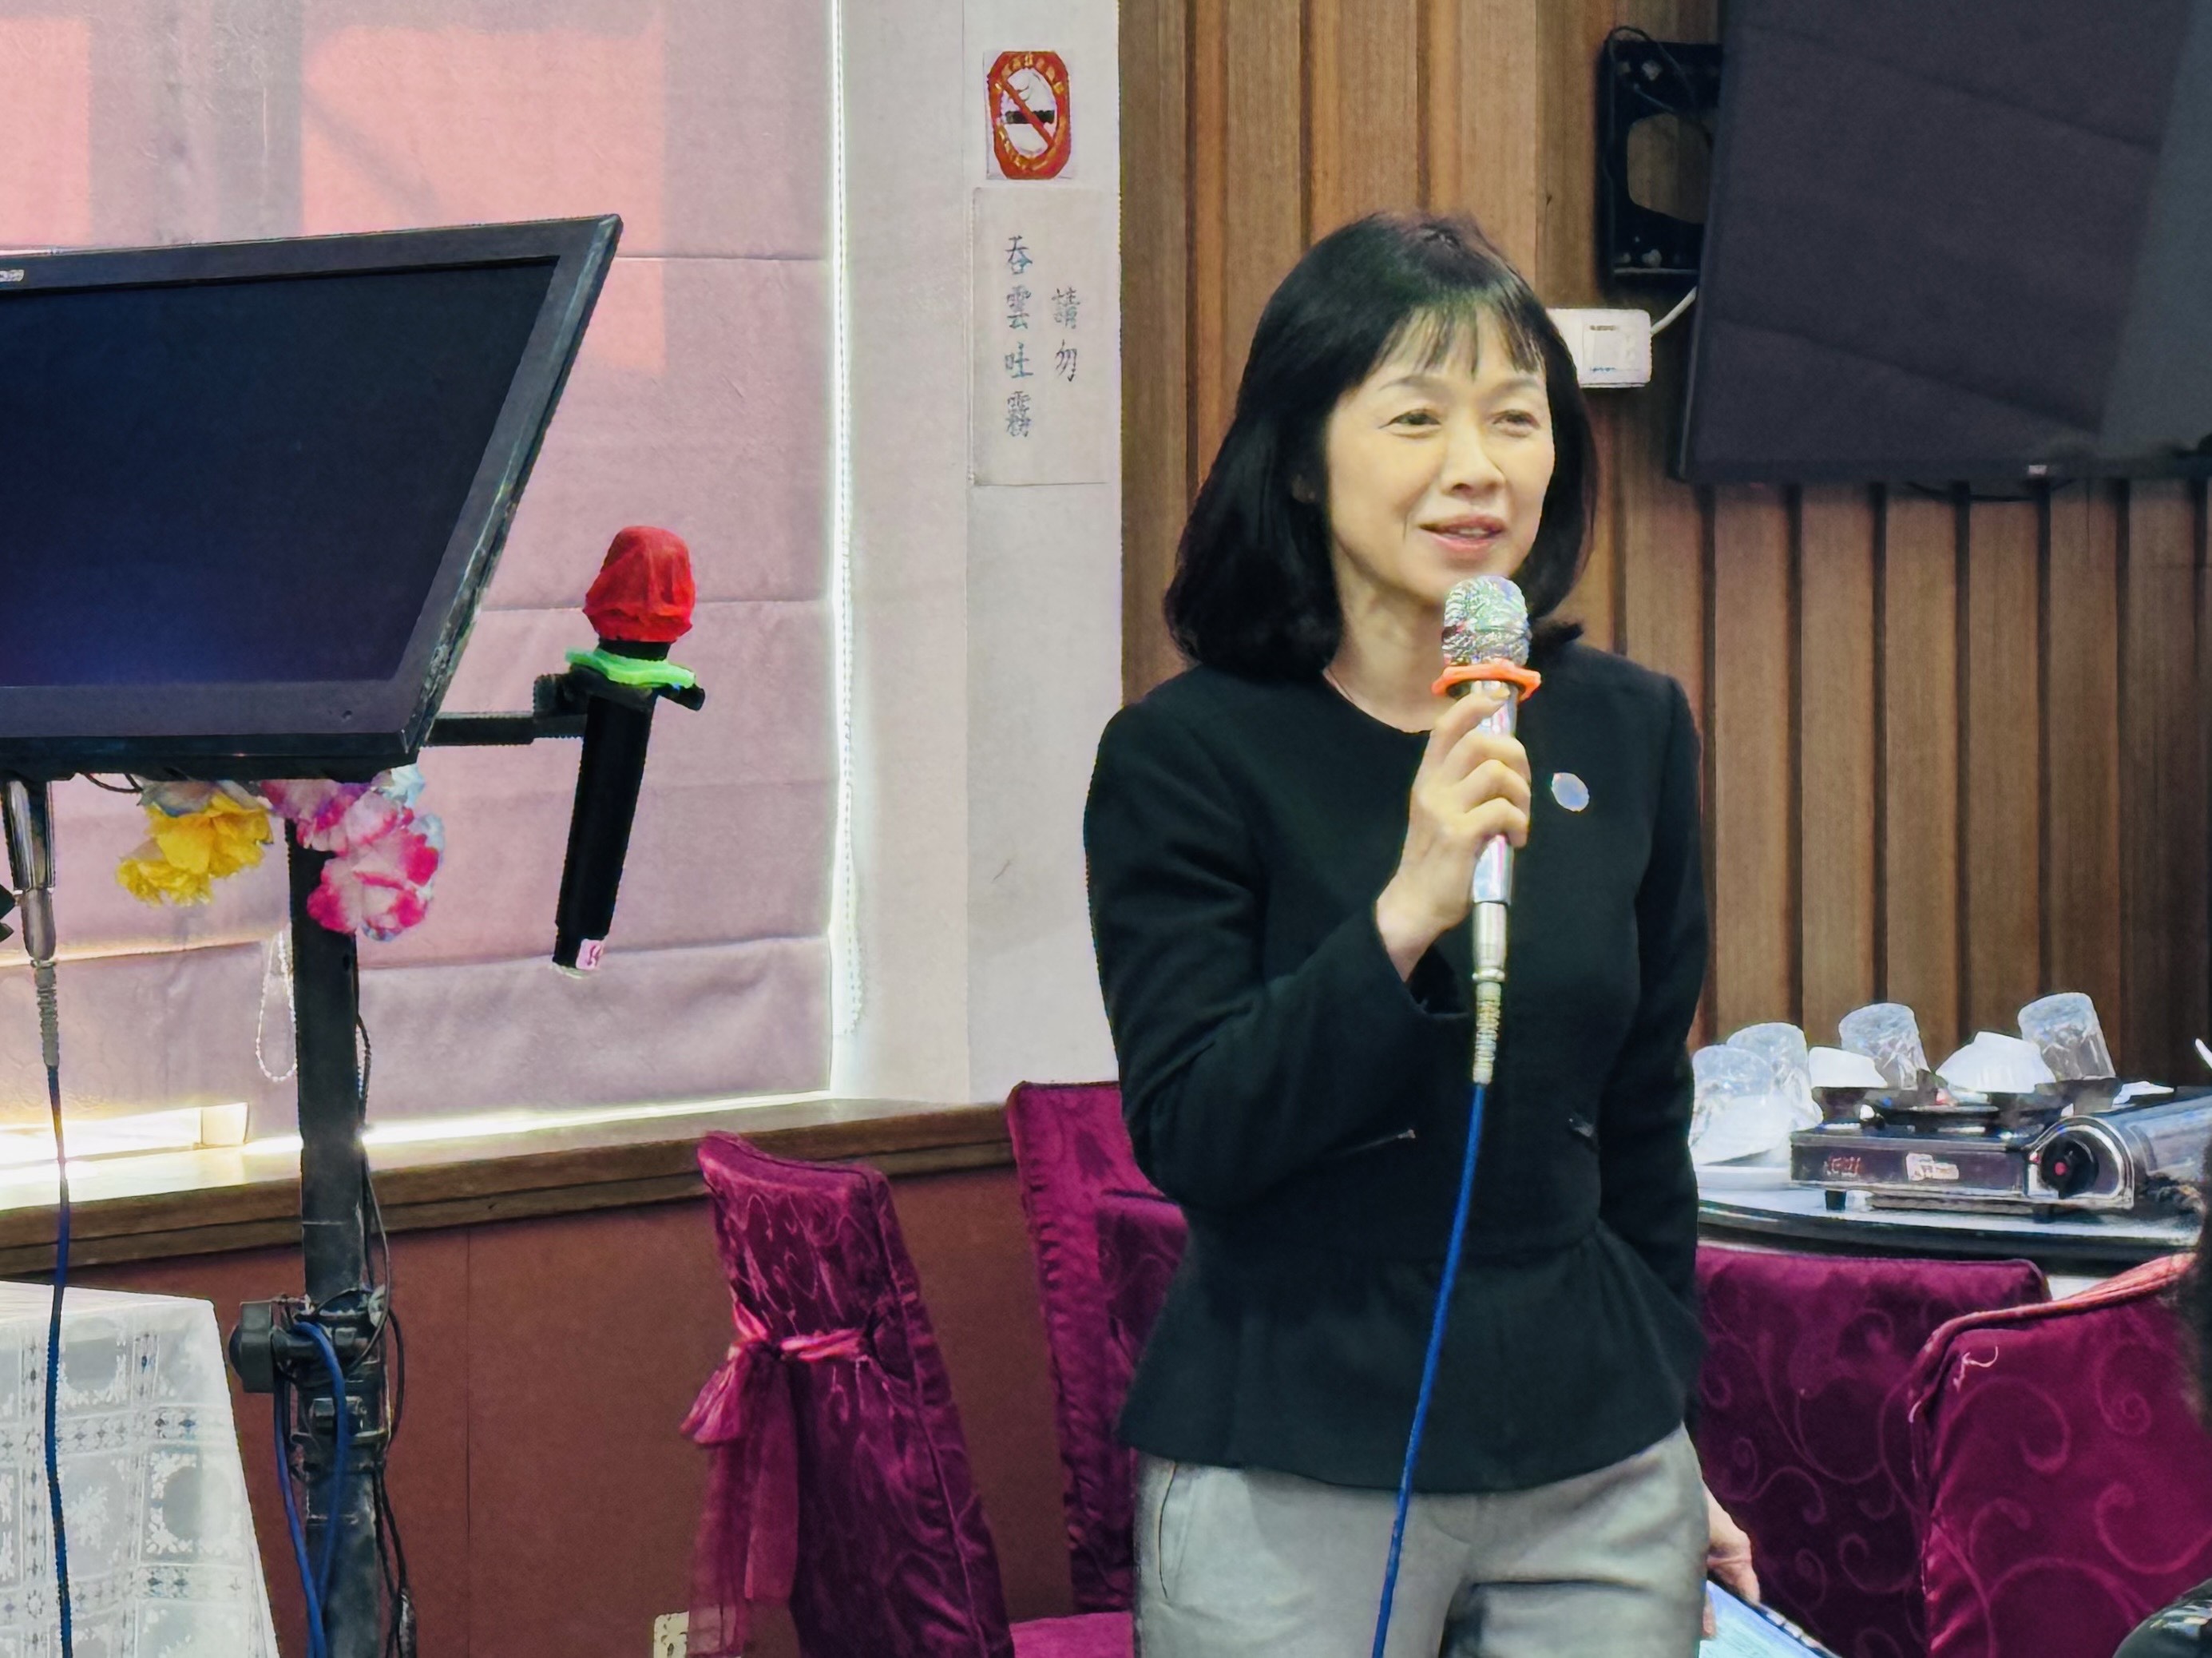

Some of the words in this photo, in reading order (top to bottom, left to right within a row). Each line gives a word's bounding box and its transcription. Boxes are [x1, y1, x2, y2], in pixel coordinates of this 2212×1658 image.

[1005, 235, 1034, 438] 吞雲吐霧
[1051, 286, 1080, 382] 請勿
